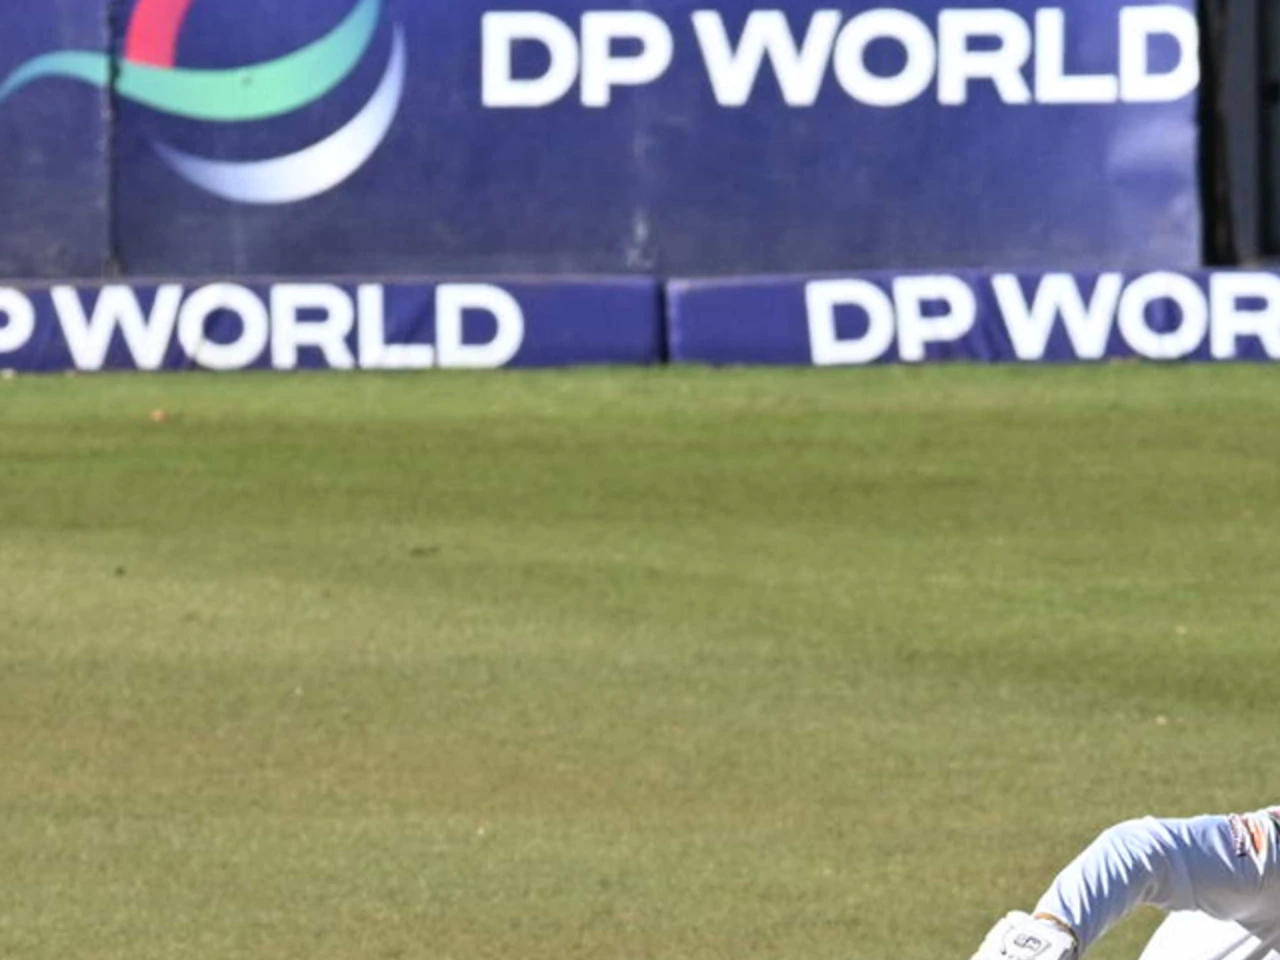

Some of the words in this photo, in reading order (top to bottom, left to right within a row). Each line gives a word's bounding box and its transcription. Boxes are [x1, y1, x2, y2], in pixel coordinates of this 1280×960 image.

[482, 11, 673, 107] DP
[692, 3, 1200, 107] WORLD
[50, 283, 524, 370] WORLD
[805, 274, 977, 366] DP
